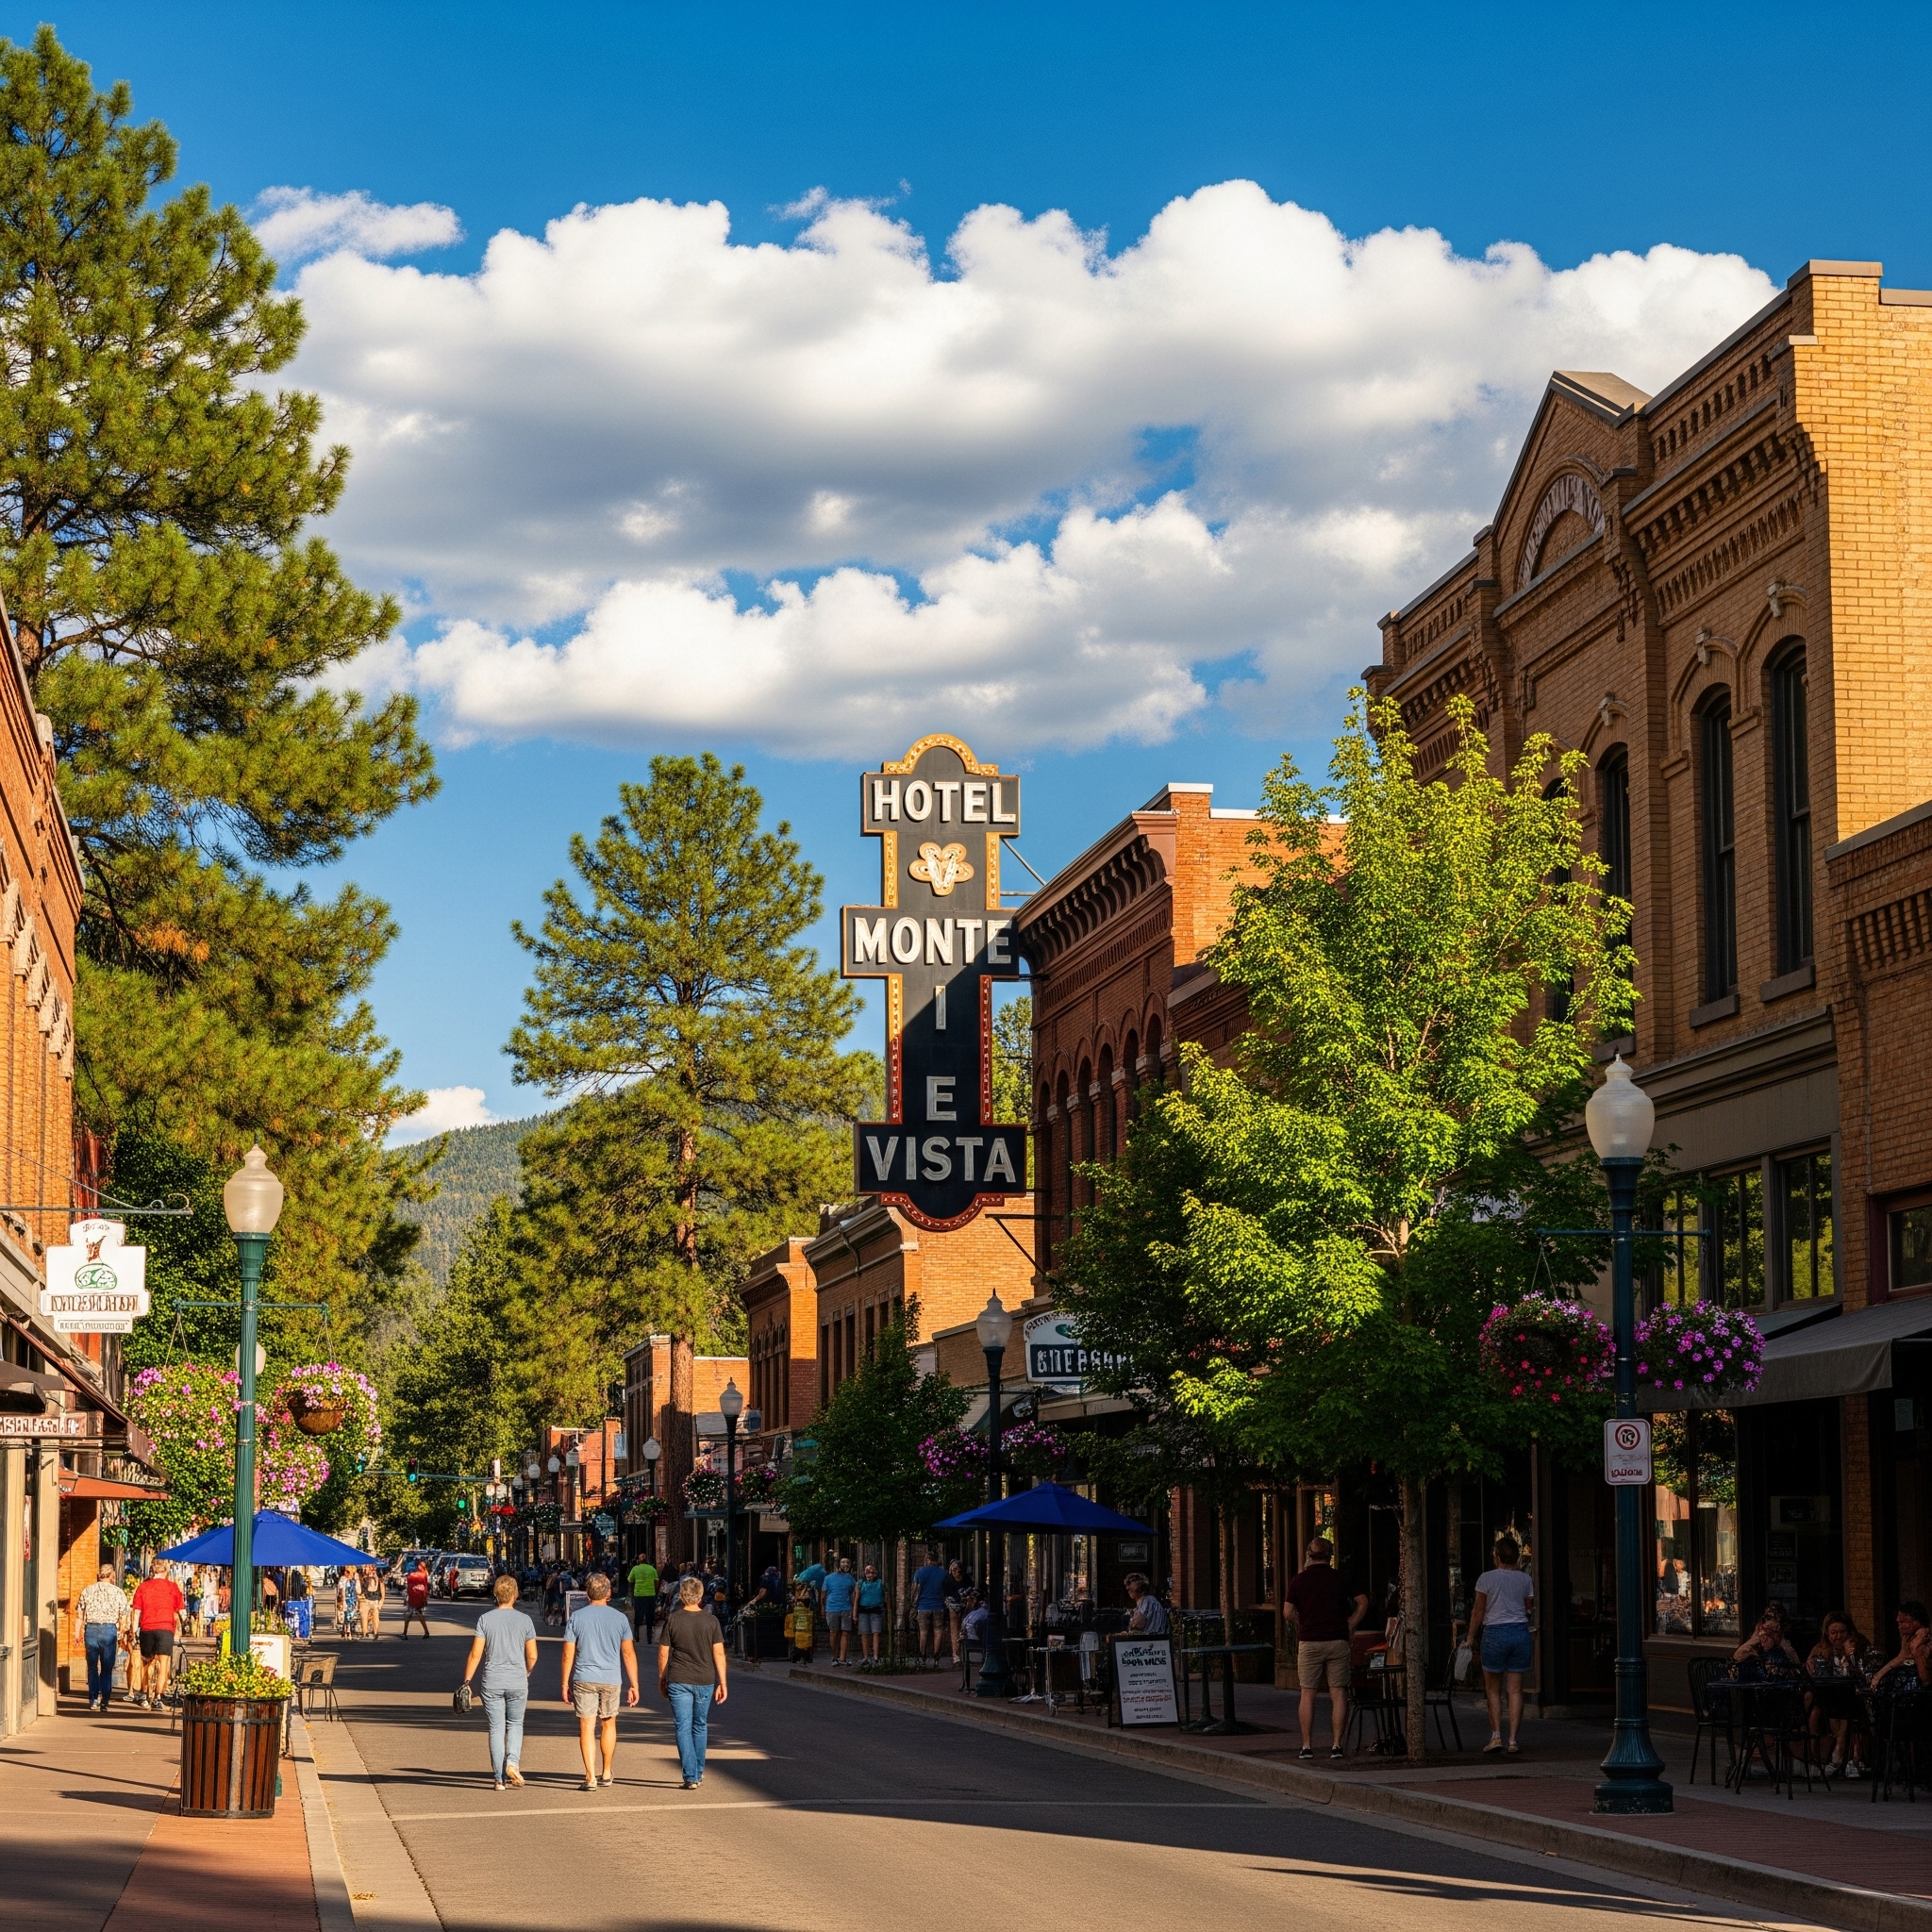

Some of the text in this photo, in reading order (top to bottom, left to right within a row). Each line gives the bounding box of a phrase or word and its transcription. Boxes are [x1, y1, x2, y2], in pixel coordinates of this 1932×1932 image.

[874, 779, 1016, 823] HOTEL
[854, 917, 1011, 965] MONTE
[926, 1075, 958, 1122] E
[865, 1136, 1016, 1183] VISTA
